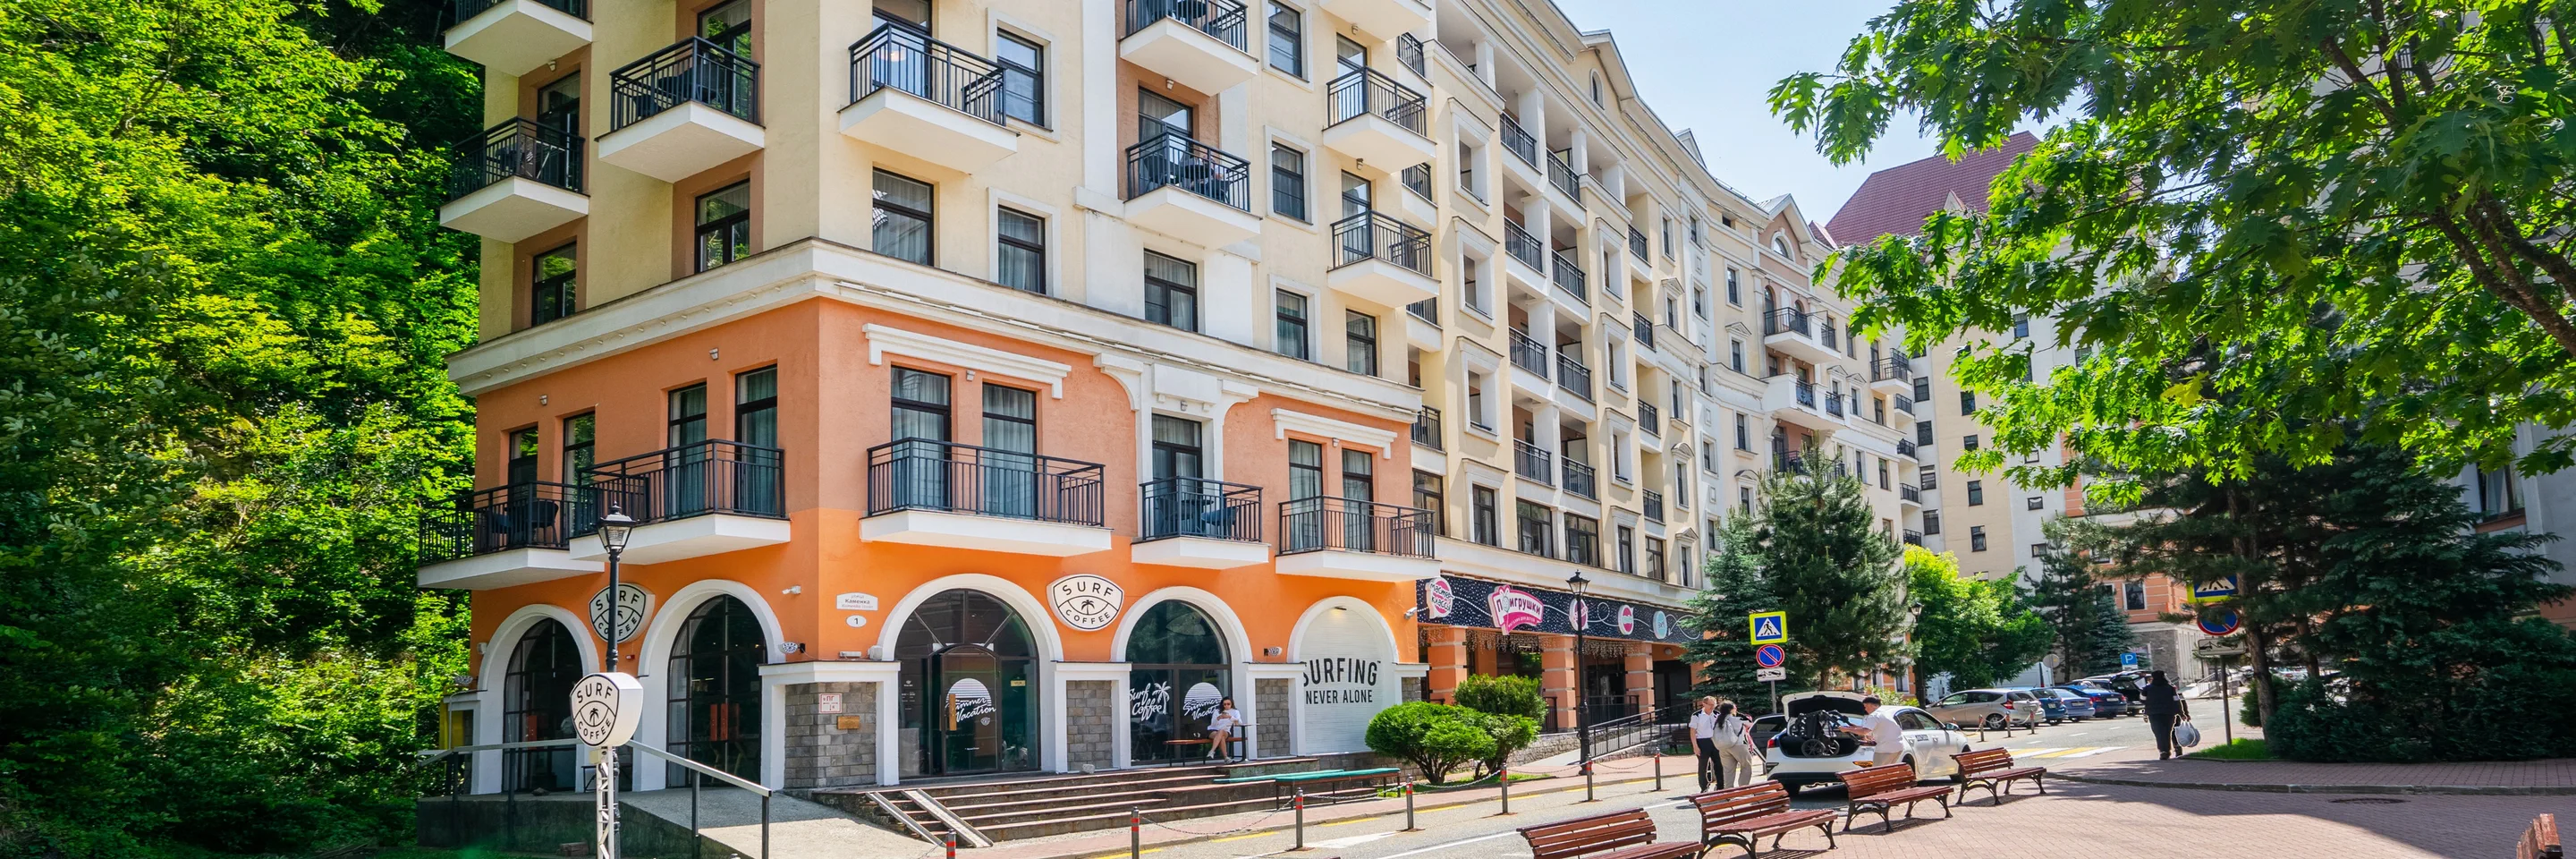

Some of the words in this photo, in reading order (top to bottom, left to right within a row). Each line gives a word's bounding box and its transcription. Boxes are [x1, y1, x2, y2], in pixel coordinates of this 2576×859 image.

[1062, 581, 1114, 596] SURF
[1065, 608, 1111, 625] COFFEE
[597, 617, 638, 636] COFEE
[577, 682, 613, 703] SURF
[1306, 690, 1338, 704] NEVER
[1343, 689, 1373, 703] ALONE
[955, 703, 996, 723] Vacation
[1131, 698, 1163, 721] Coffee
[578, 719, 611, 739] COFFEE
